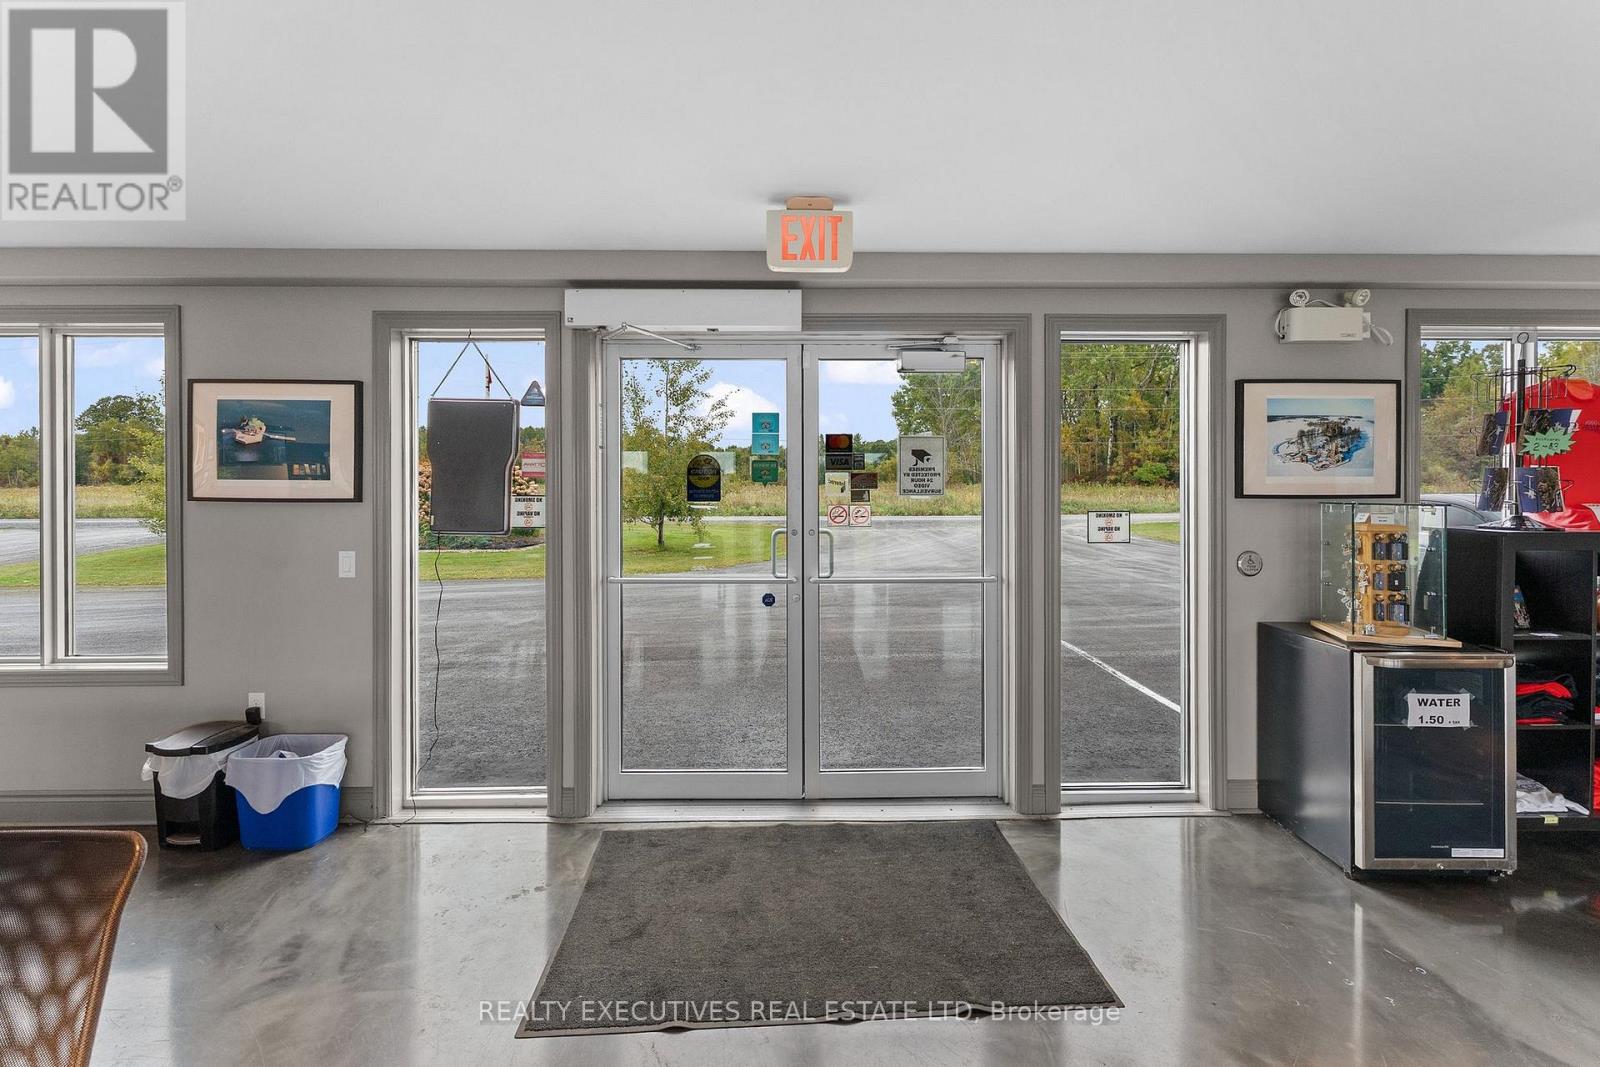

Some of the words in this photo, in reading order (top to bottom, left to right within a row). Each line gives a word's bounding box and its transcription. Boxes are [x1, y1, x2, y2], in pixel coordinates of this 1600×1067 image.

[781, 214, 843, 261] EXIT
[830, 457, 850, 466] VISA
[1417, 698, 1461, 707] WATER
[1418, 715, 1445, 724] 1.50
